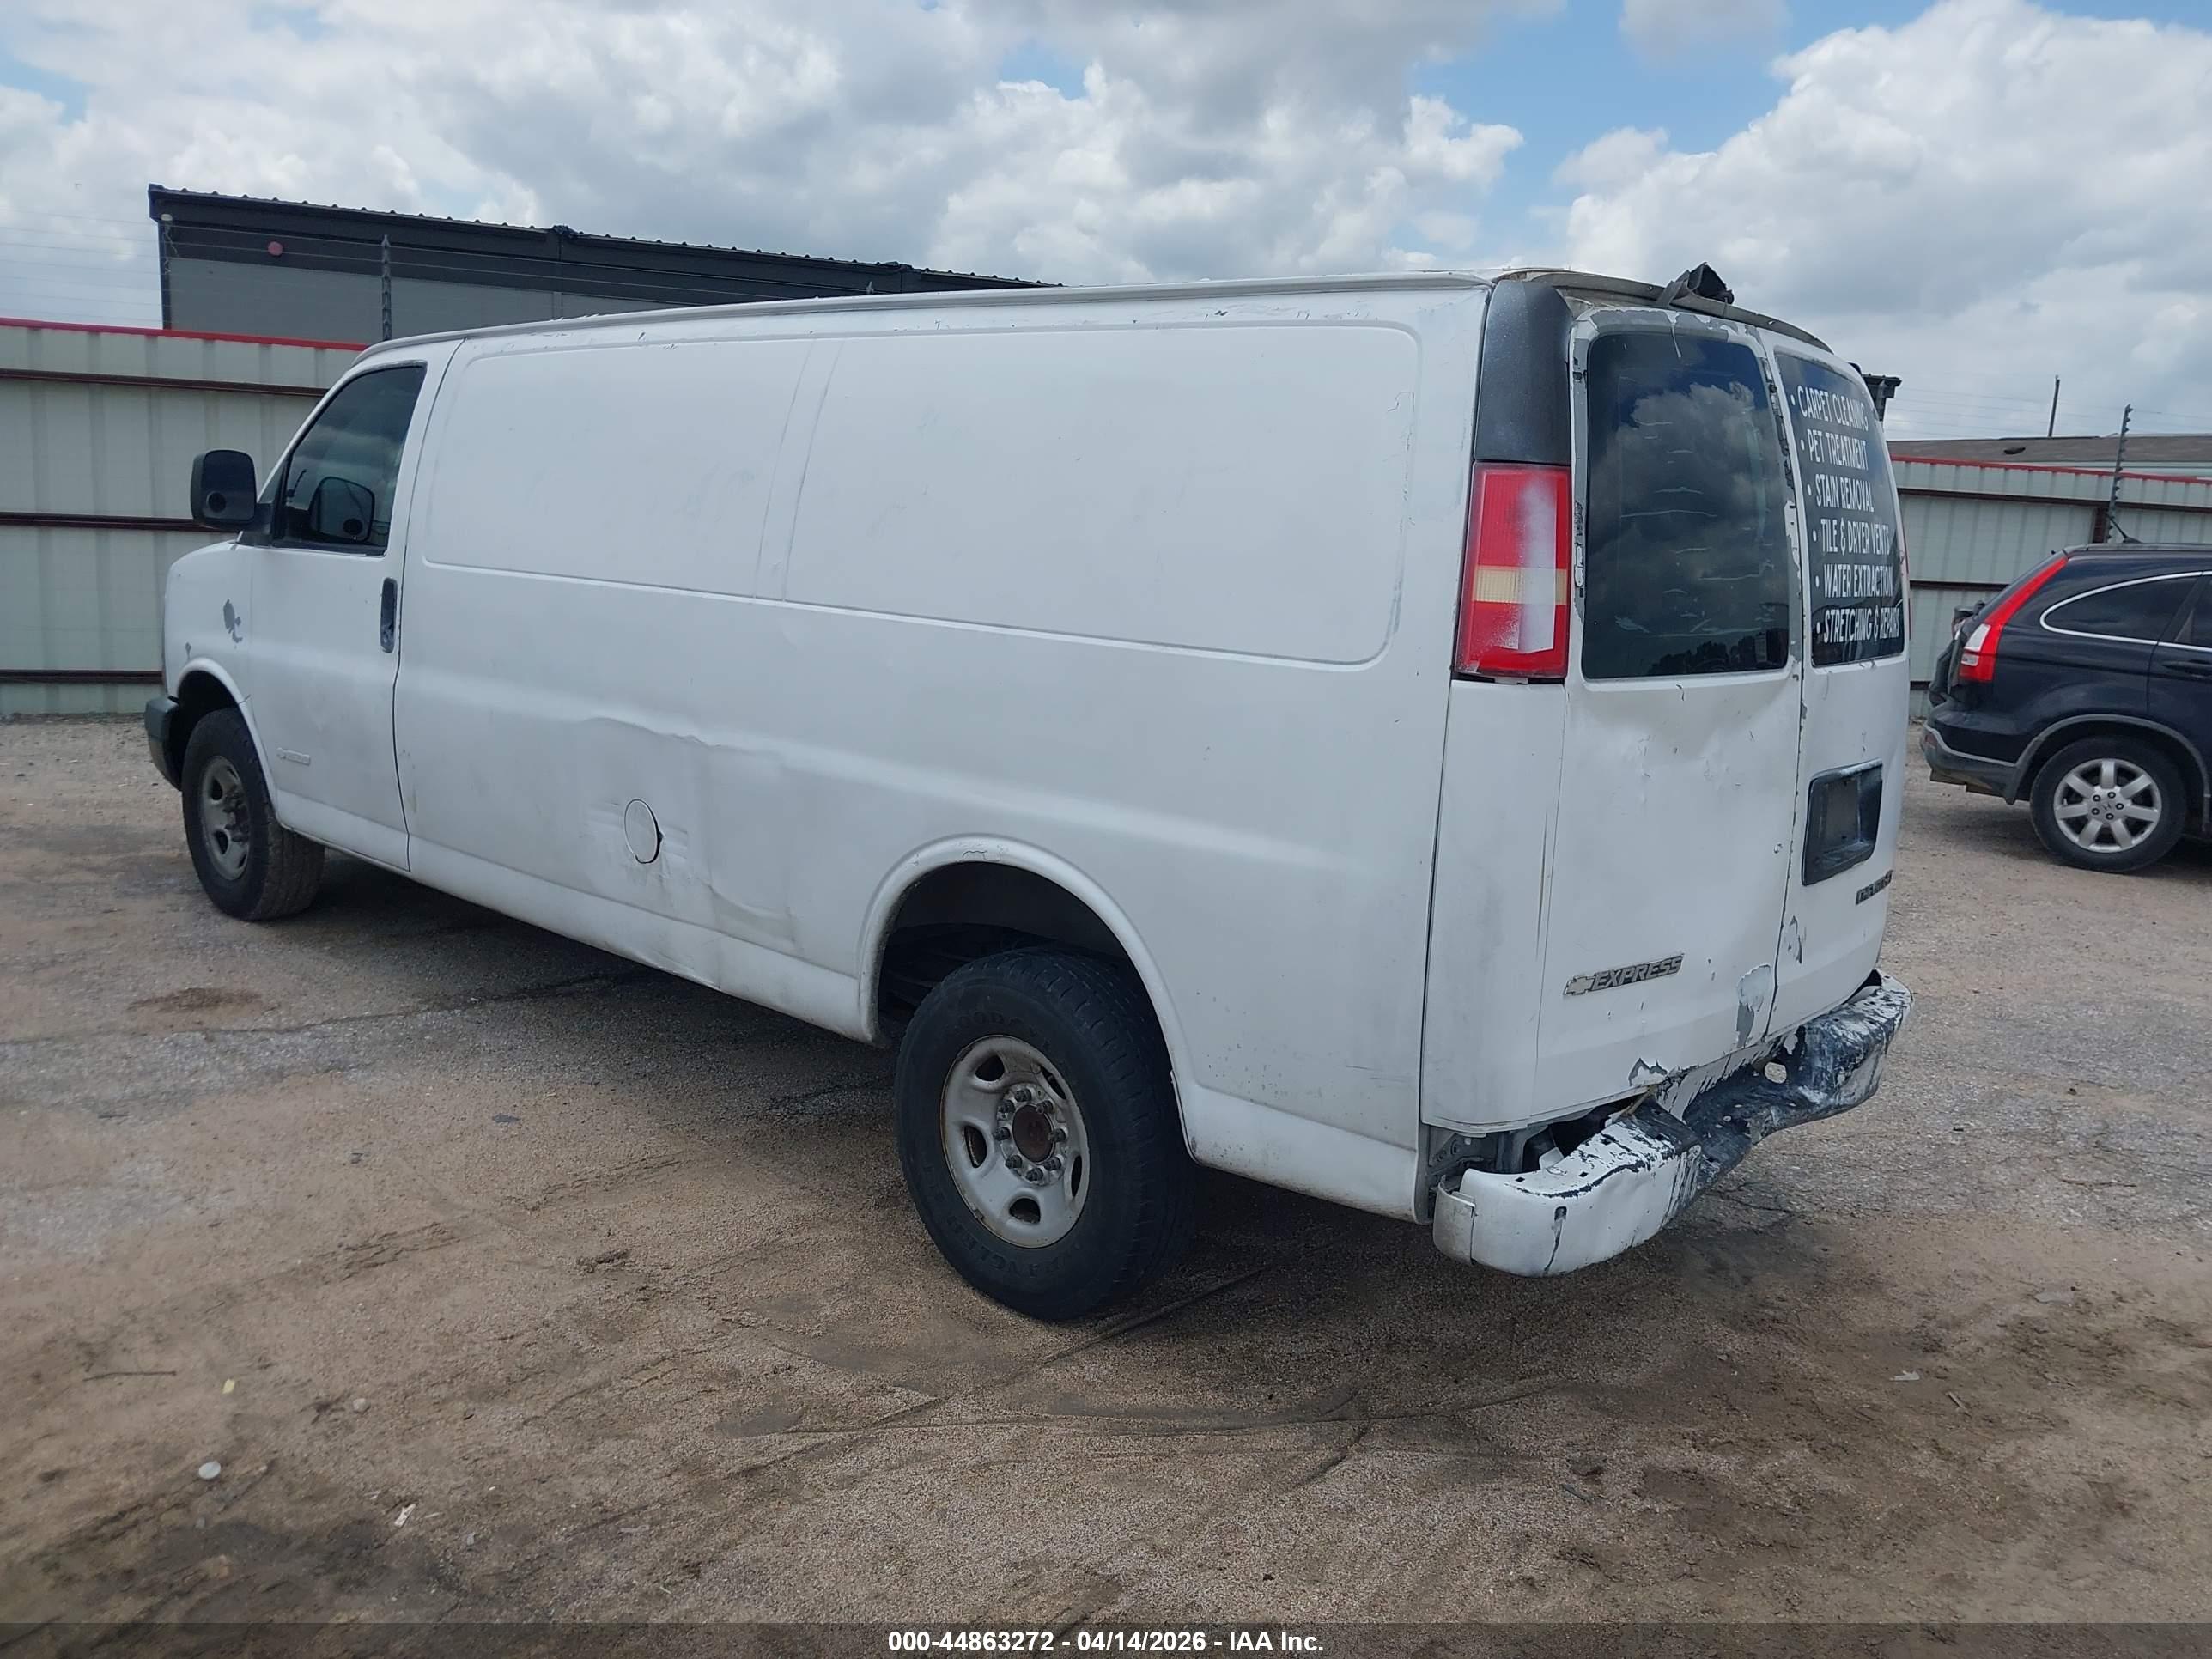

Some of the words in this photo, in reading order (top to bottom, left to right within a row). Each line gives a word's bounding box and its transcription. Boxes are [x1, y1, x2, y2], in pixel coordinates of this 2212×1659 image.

[1798, 386, 1832, 422] CARPET
[1832, 393, 1869, 431] CLEANING
[1807, 429, 1825, 463] PET
[1826, 432, 1869, 471] TREATMENT
[1815, 474, 1839, 508] STAIN
[1840, 477, 1875, 513] REMOVAL
[1820, 518, 1838, 553] TILE
[1840, 517, 1846, 556] &
[1847, 520, 1870, 554] DRYER
[1870, 524, 1891, 556] VENTS
[1824, 564, 1851, 598] WATER
[1853, 564, 1893, 598] EXTRACTION
[1824, 608, 1872, 643] STRETCHING
[1874, 605, 1879, 641] &
[1880, 607, 1900, 639] REPAIRS
[1591, 955, 1683, 991] EXPRESS
